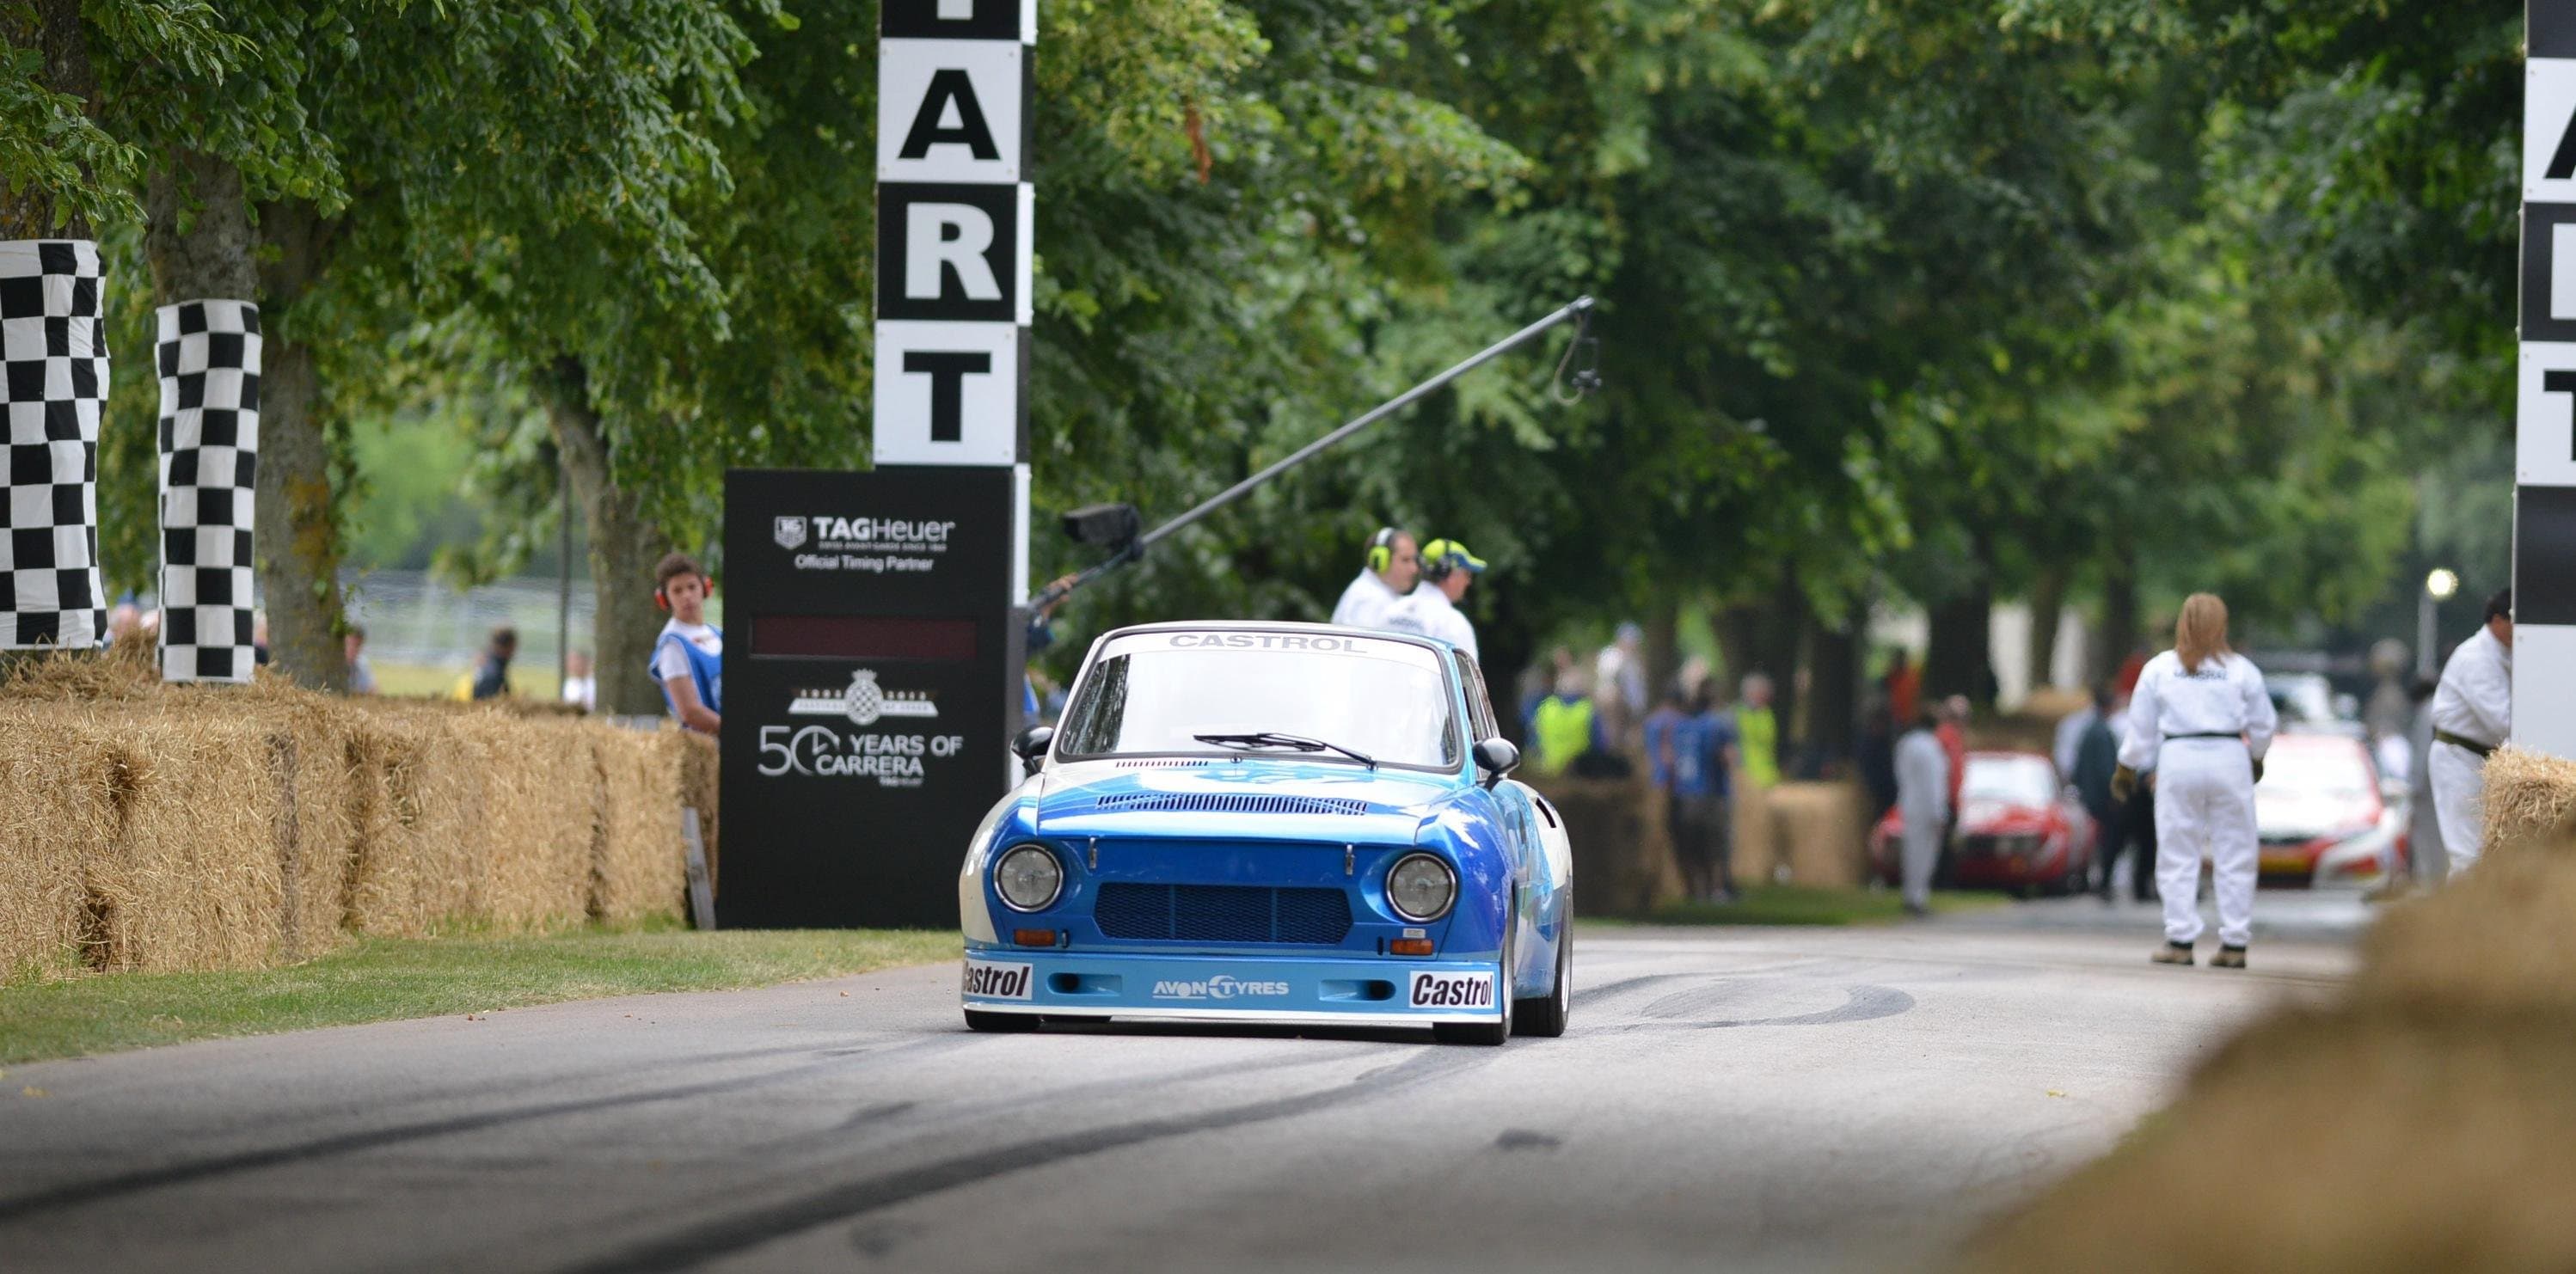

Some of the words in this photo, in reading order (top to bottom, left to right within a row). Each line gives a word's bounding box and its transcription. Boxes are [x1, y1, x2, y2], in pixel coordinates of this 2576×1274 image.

[899, 0, 1003, 442] ART
[794, 554, 839, 570] Official
[841, 554, 884, 573] Timing
[886, 555, 934, 571] Partner
[1169, 634, 1368, 653] CASTROL
[757, 725, 840, 776] 50
[849, 733, 925, 756] YEARS
[930, 735, 963, 756] OF
[815, 754, 924, 776] CARRERA
[1153, 981, 1206, 997] AVON
[1220, 982, 1290, 995] TYRES
[1412, 974, 1493, 1006] Castrol
